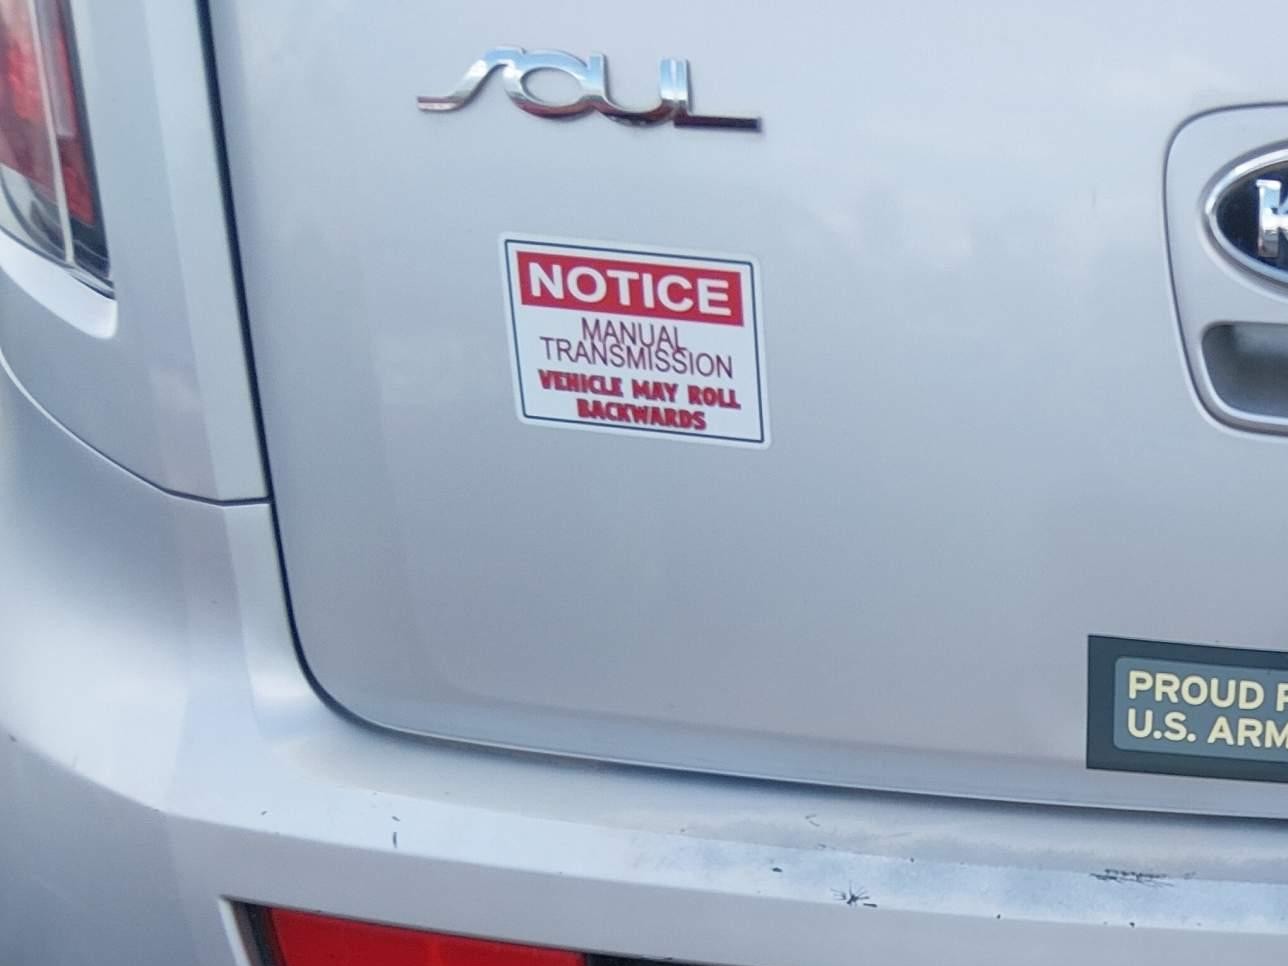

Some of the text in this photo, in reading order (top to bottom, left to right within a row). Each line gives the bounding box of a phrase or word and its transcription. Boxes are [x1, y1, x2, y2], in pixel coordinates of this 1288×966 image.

[416, 44, 765, 133] SOUL
[528, 261, 733, 317] NOTICE
[581, 317, 688, 353] MANUAL
[539, 336, 734, 378] TRANSMISSION
[538, 369, 742, 410] VEHICLE MAY ROLL
[576, 398, 707, 431] BACKWARDS
[1127, 669, 1266, 711] PROUD
[1126, 707, 1197, 743] U.S.
